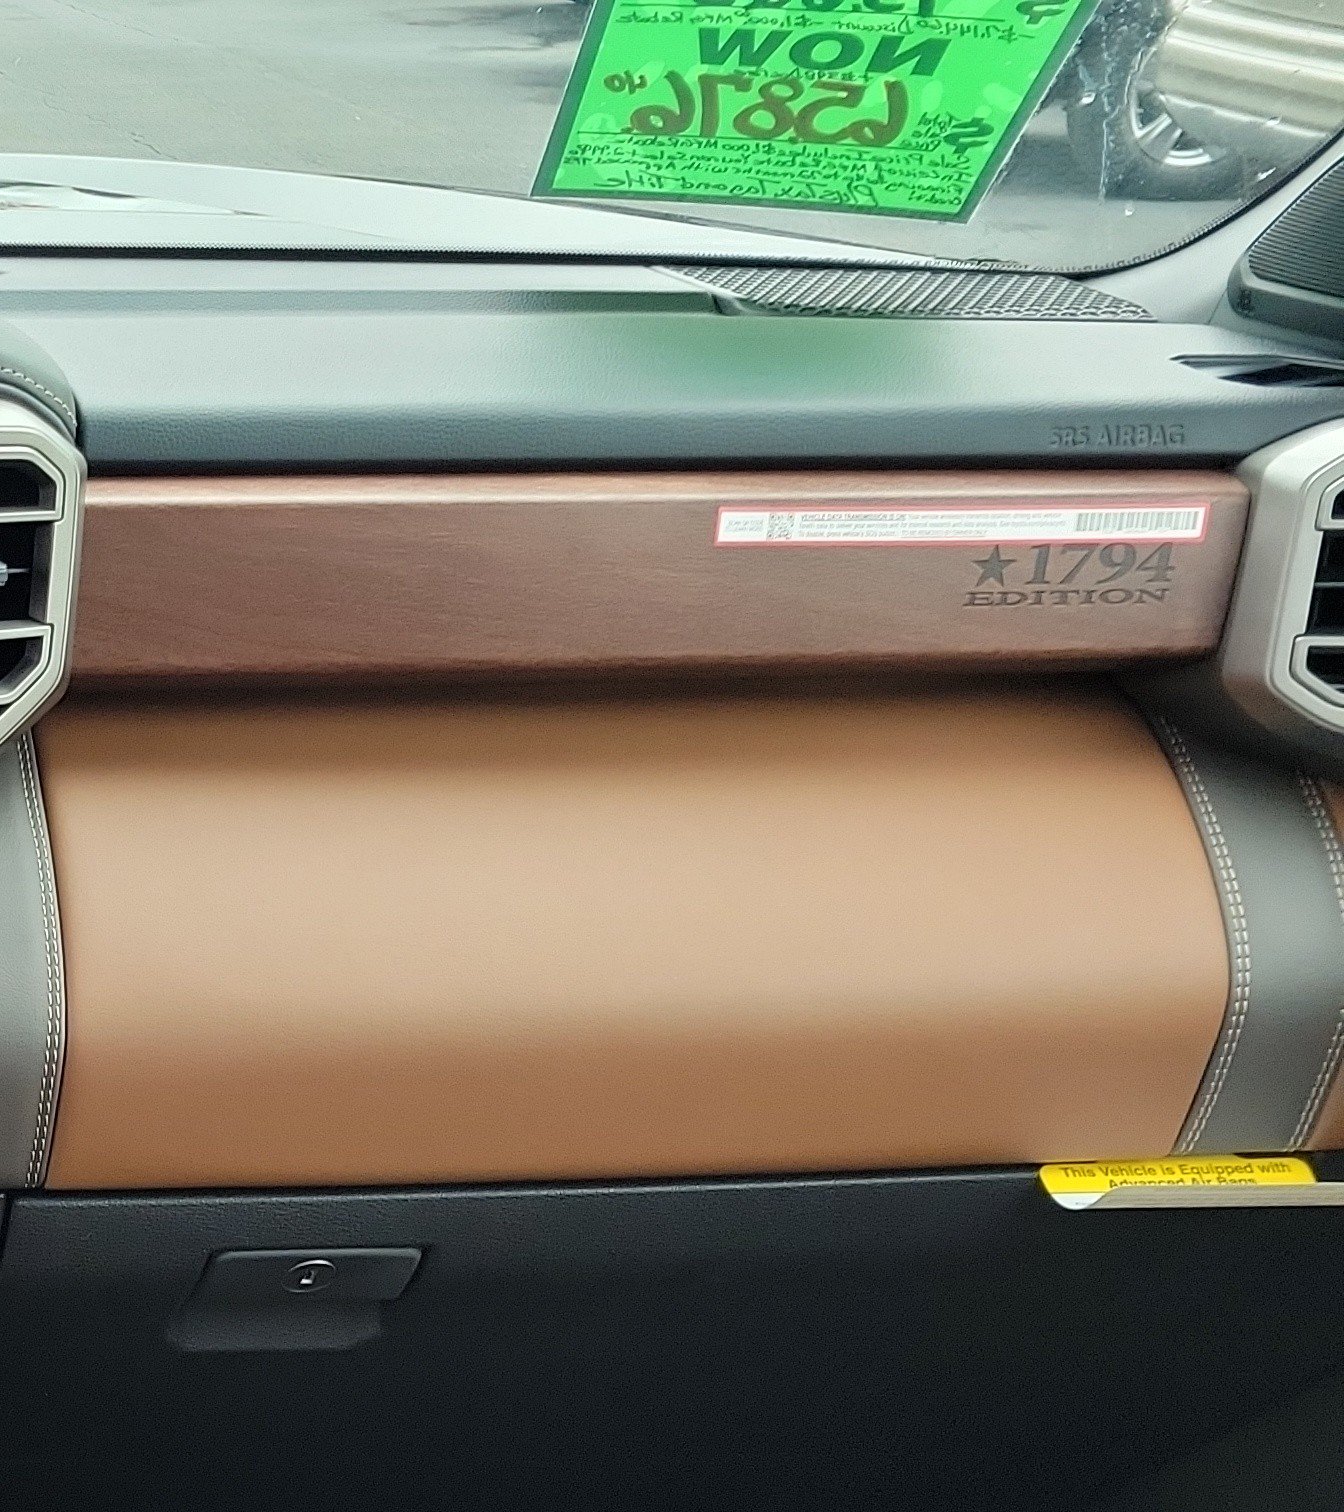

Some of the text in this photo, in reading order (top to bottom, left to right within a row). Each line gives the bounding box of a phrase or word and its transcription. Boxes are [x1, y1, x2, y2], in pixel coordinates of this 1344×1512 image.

[1049, 424, 1184, 447] SRS AIRBAG
[1025, 542, 1176, 585] 1794
[962, 588, 1170, 607] EDITION
[1061, 1161, 1292, 1181] This Vehicle is Equipped with
